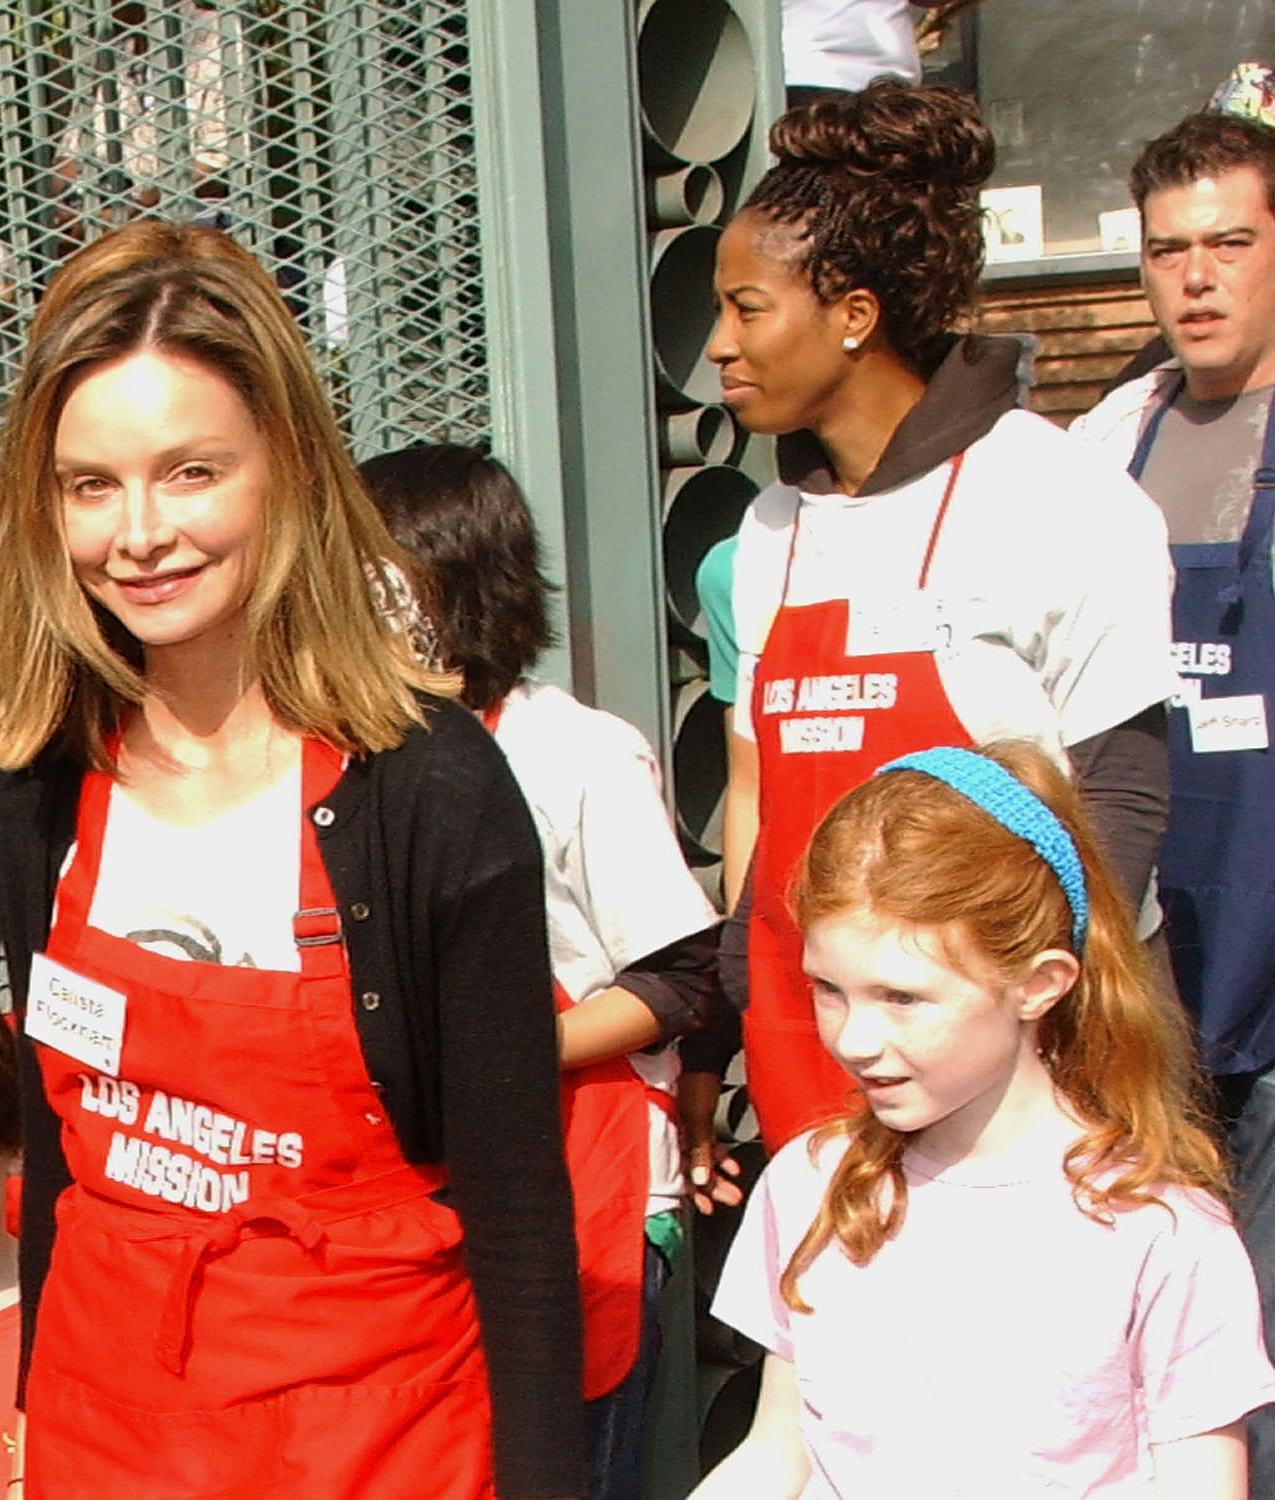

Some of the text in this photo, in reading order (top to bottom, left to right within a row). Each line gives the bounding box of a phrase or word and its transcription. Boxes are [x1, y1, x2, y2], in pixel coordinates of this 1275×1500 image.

[762, 673, 898, 715] LOS ANGELES
[779, 715, 865, 754] MISSION
[77, 1072, 304, 1169] LOS ANGELES
[105, 1131, 249, 1213] MISSION
